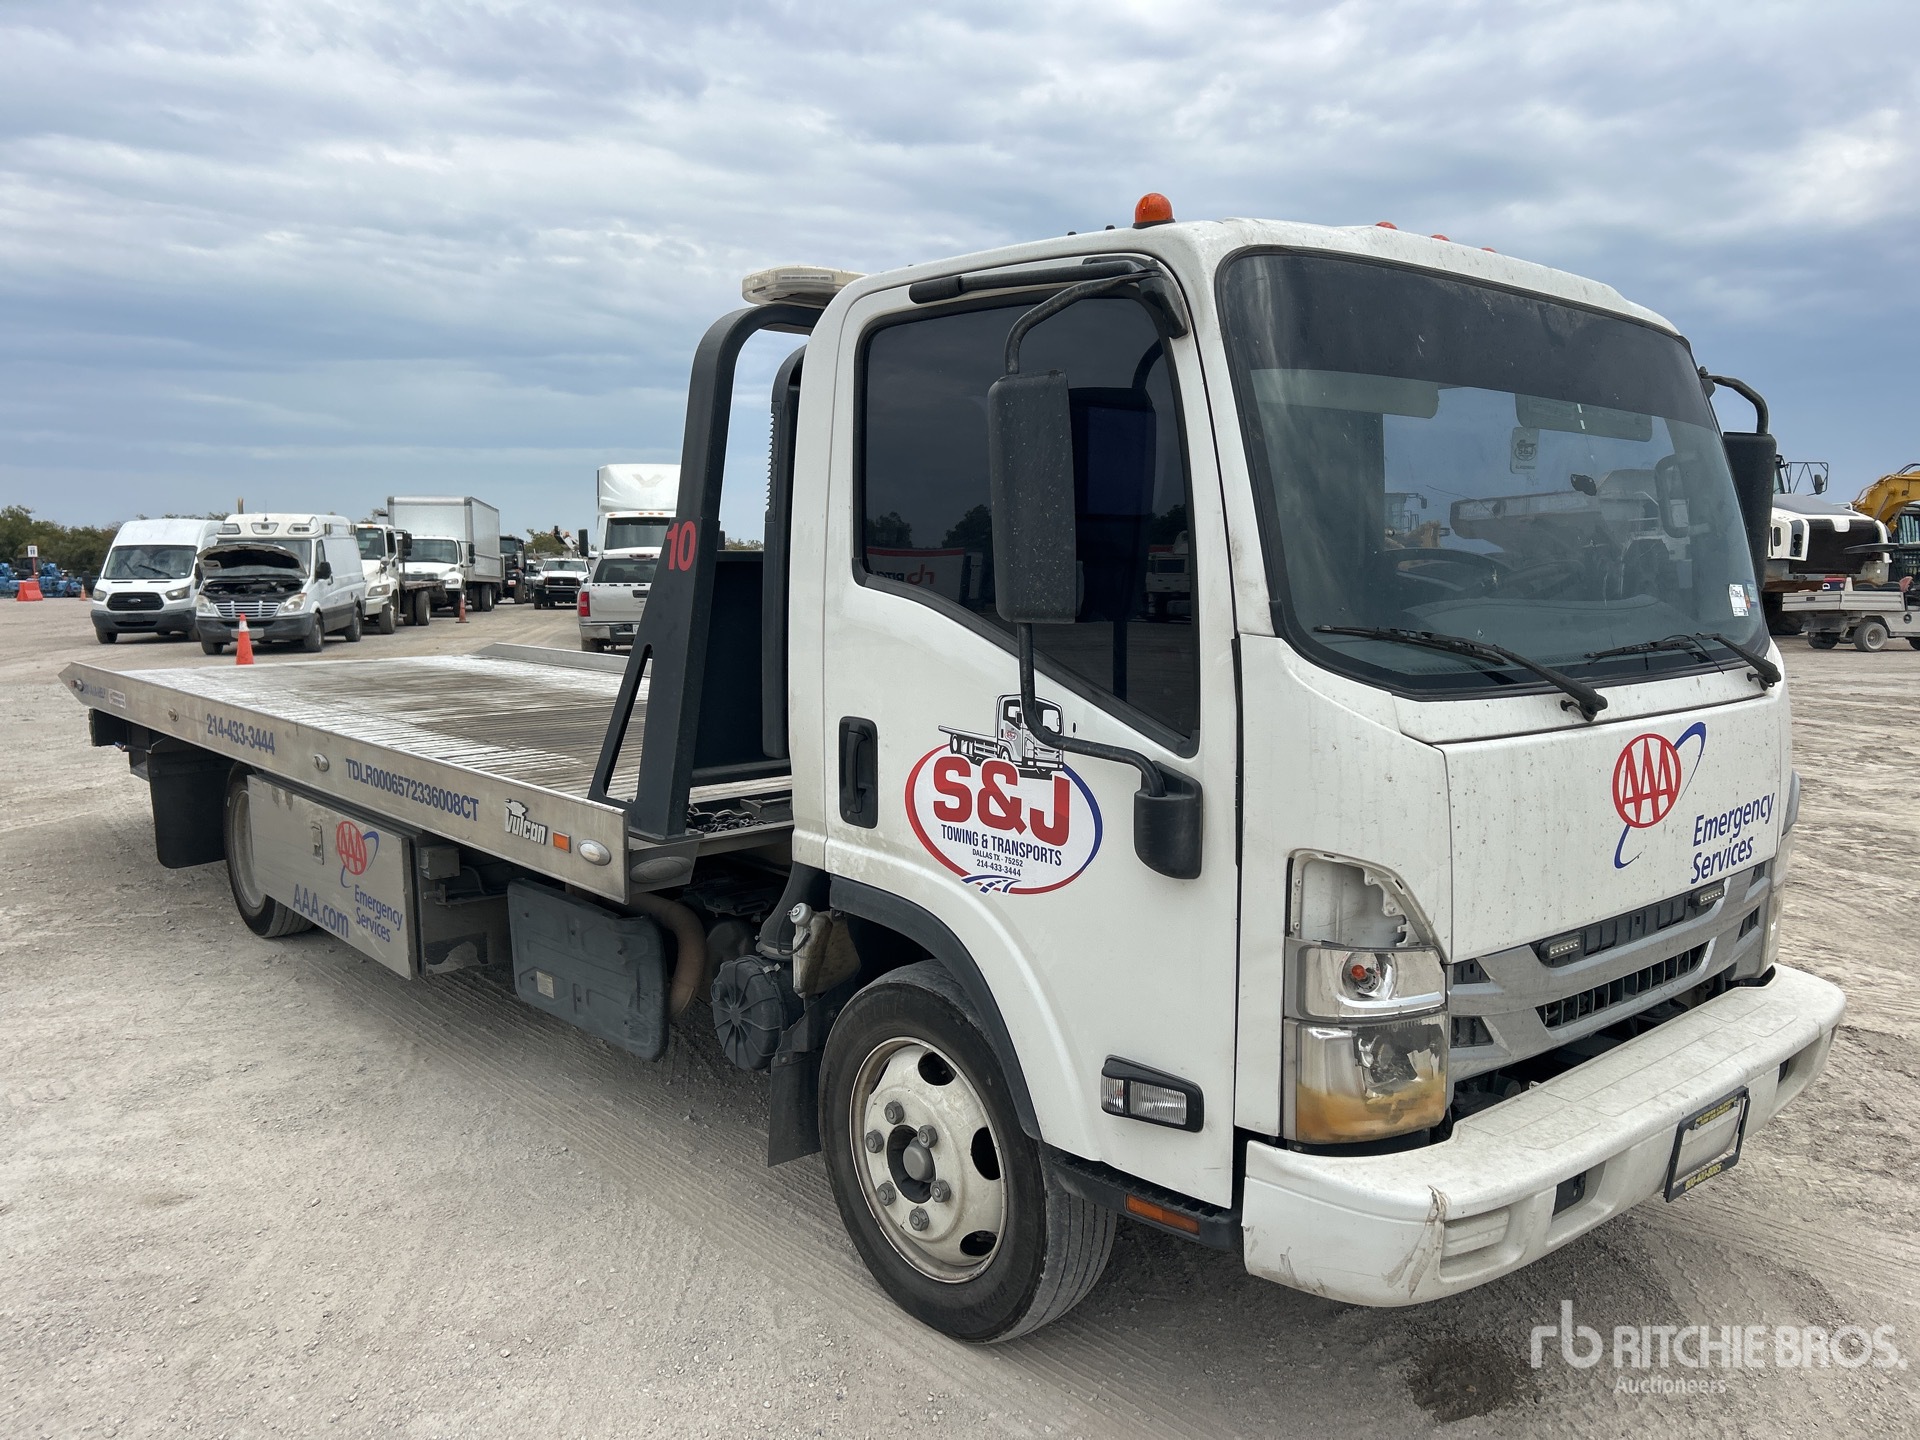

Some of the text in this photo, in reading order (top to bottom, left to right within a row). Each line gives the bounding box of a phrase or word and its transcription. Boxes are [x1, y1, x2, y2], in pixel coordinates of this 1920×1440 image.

[666, 520, 697, 572] 10
[206, 712, 276, 756] 214-433-3444
[345, 758, 480, 822] TDLR0006572336008CT
[933, 755, 1071, 847] S&J
[1614, 735, 1680, 826] AAA
[941, 823, 1062, 866] TOWING & TRANSPORTS
[1692, 792, 1776, 848] Emergency
[337, 821, 367, 875] AAA
[972, 848, 993, 860] DALLAS
[993, 853, 1001, 862] TX
[1004, 856, 1024, 868] 75252
[976, 858, 1021, 877] 214-433-3444
[1690, 836, 1754, 885] Services
[292, 883, 349, 938] AAA.com
[354, 884, 403, 931] Emergency
[356, 907, 391, 943] Services
